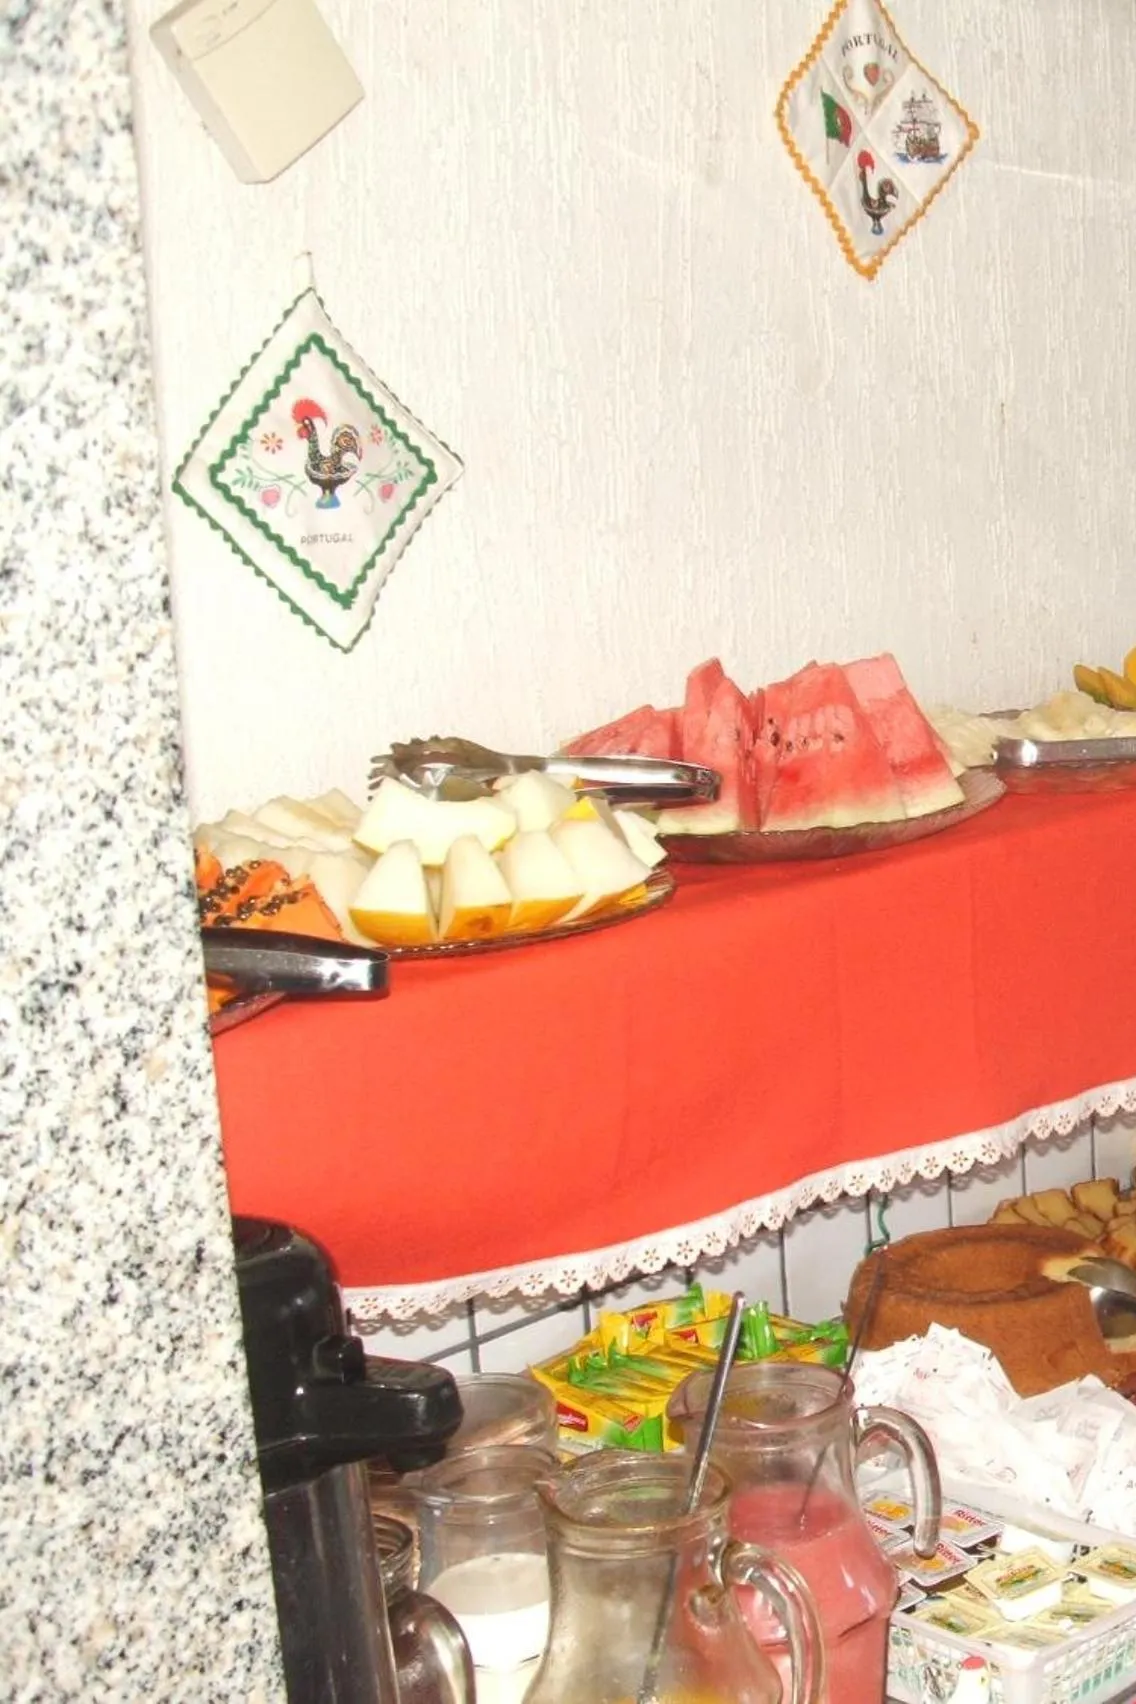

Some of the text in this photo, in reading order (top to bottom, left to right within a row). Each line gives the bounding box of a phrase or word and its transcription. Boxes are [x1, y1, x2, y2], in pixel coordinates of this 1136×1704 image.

[300, 533, 352, 545] PORTUGAL
[953, 1509, 986, 1528] Ritter
[936, 1542, 961, 1566] Ritter
